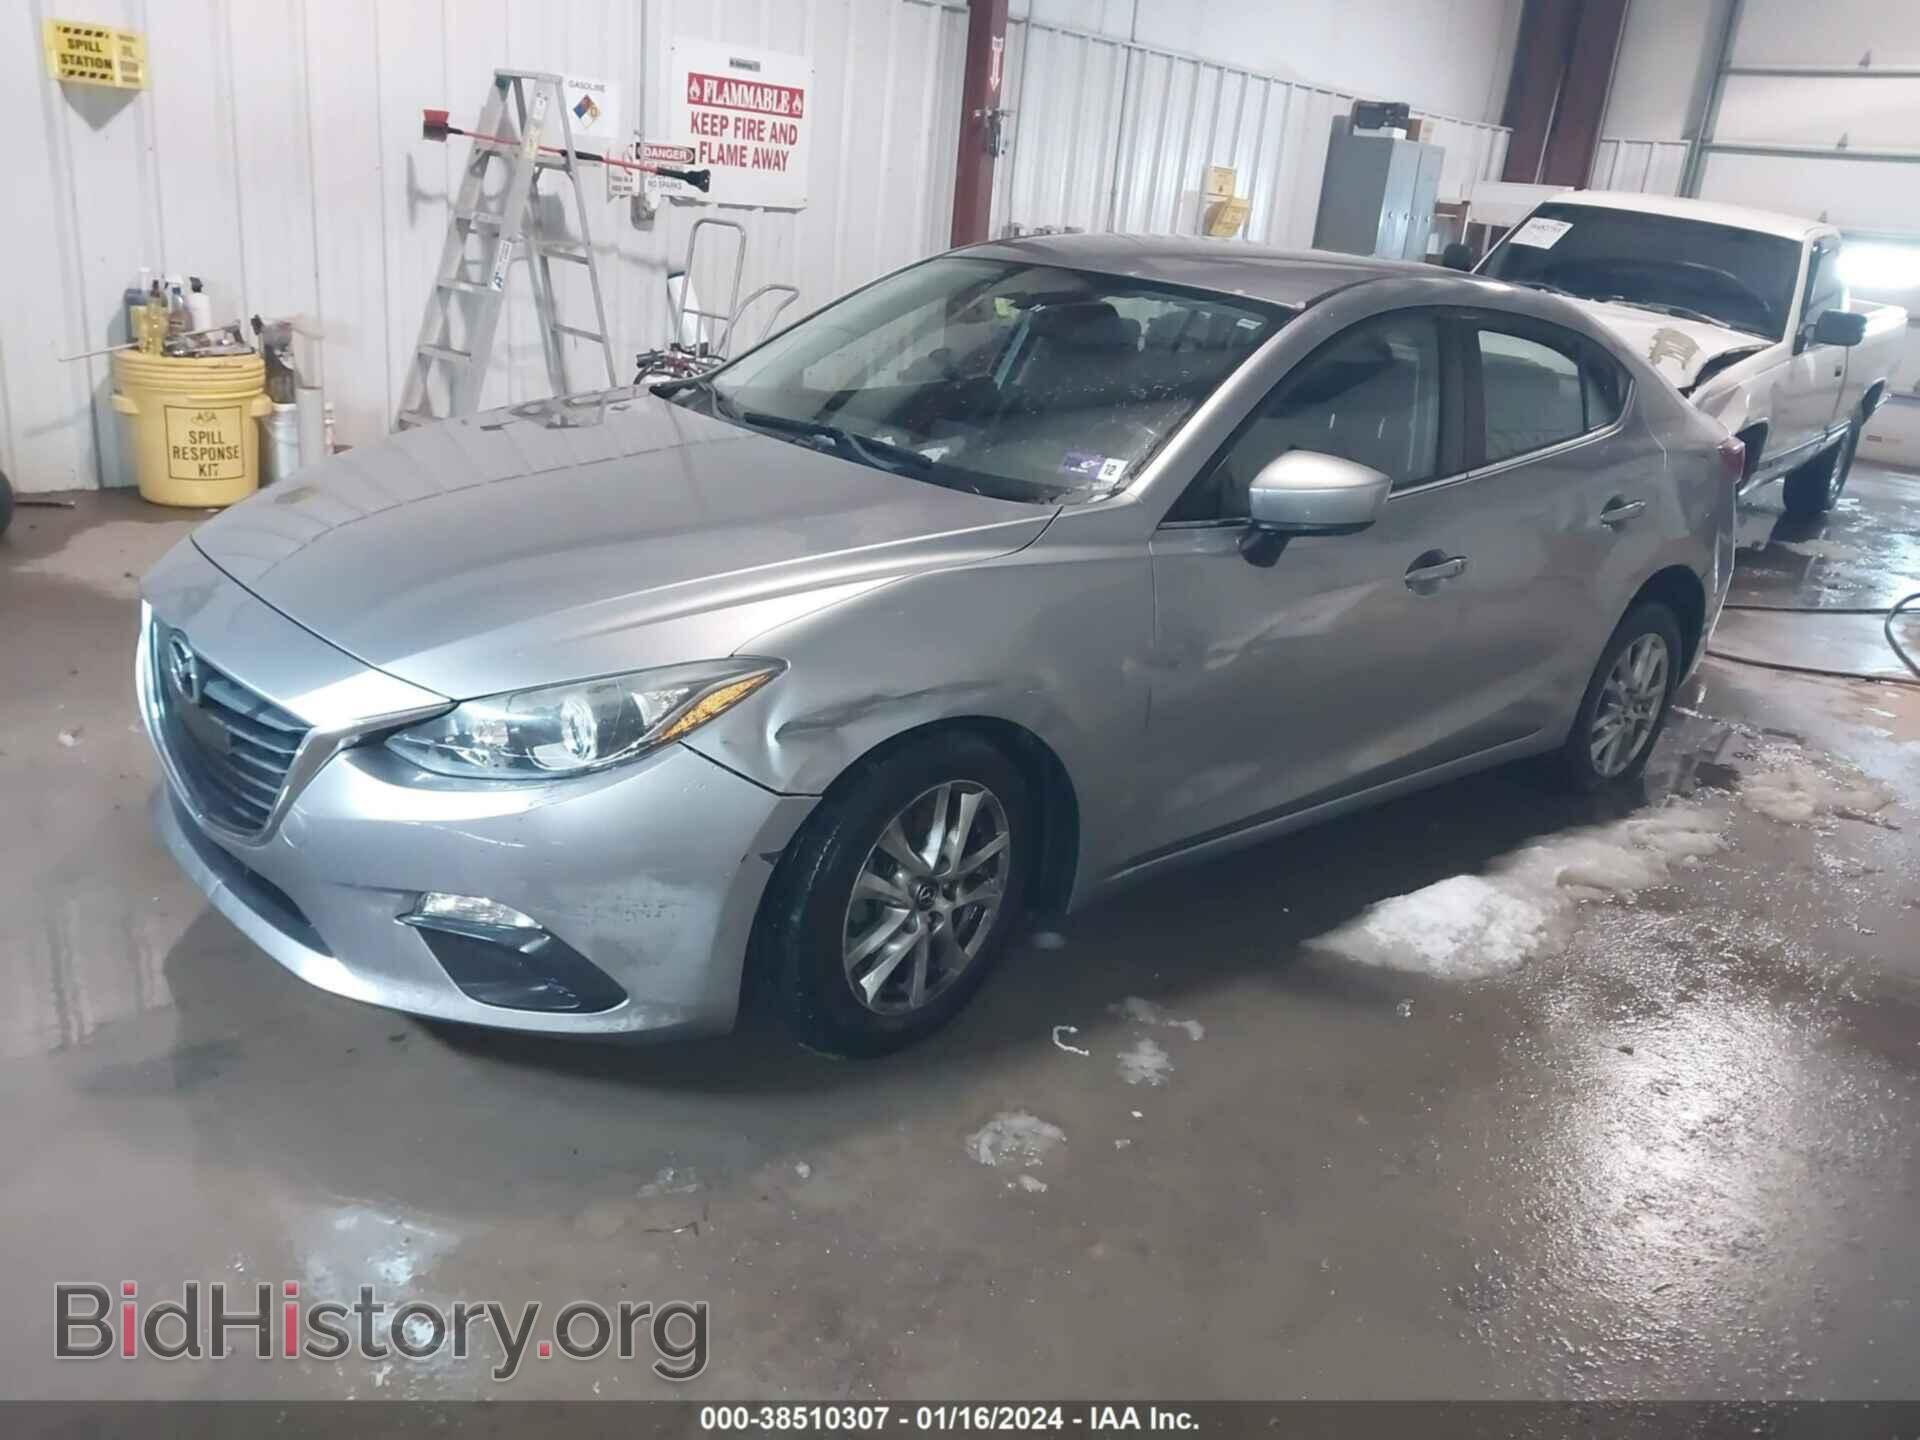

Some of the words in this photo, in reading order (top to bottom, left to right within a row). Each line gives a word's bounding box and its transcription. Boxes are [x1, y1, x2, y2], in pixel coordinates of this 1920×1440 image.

[67, 38, 103, 53] SPILL
[61, 53, 113, 69] STATION
[568, 79, 605, 92] GASOLINE
[703, 78, 790, 113] FLAMMABLE
[690, 111, 729, 137] KEEP
[734, 117, 766, 142] FIRE
[769, 122, 798, 146] AND
[645, 147, 687, 160] DANGER
[699, 141, 748, 168] FLAME
[751, 147, 789, 172] AWAY
[188, 430, 225, 445] SPILL
[172, 445, 240, 461] RESPONSE
[198, 463, 219, 477] KIT
